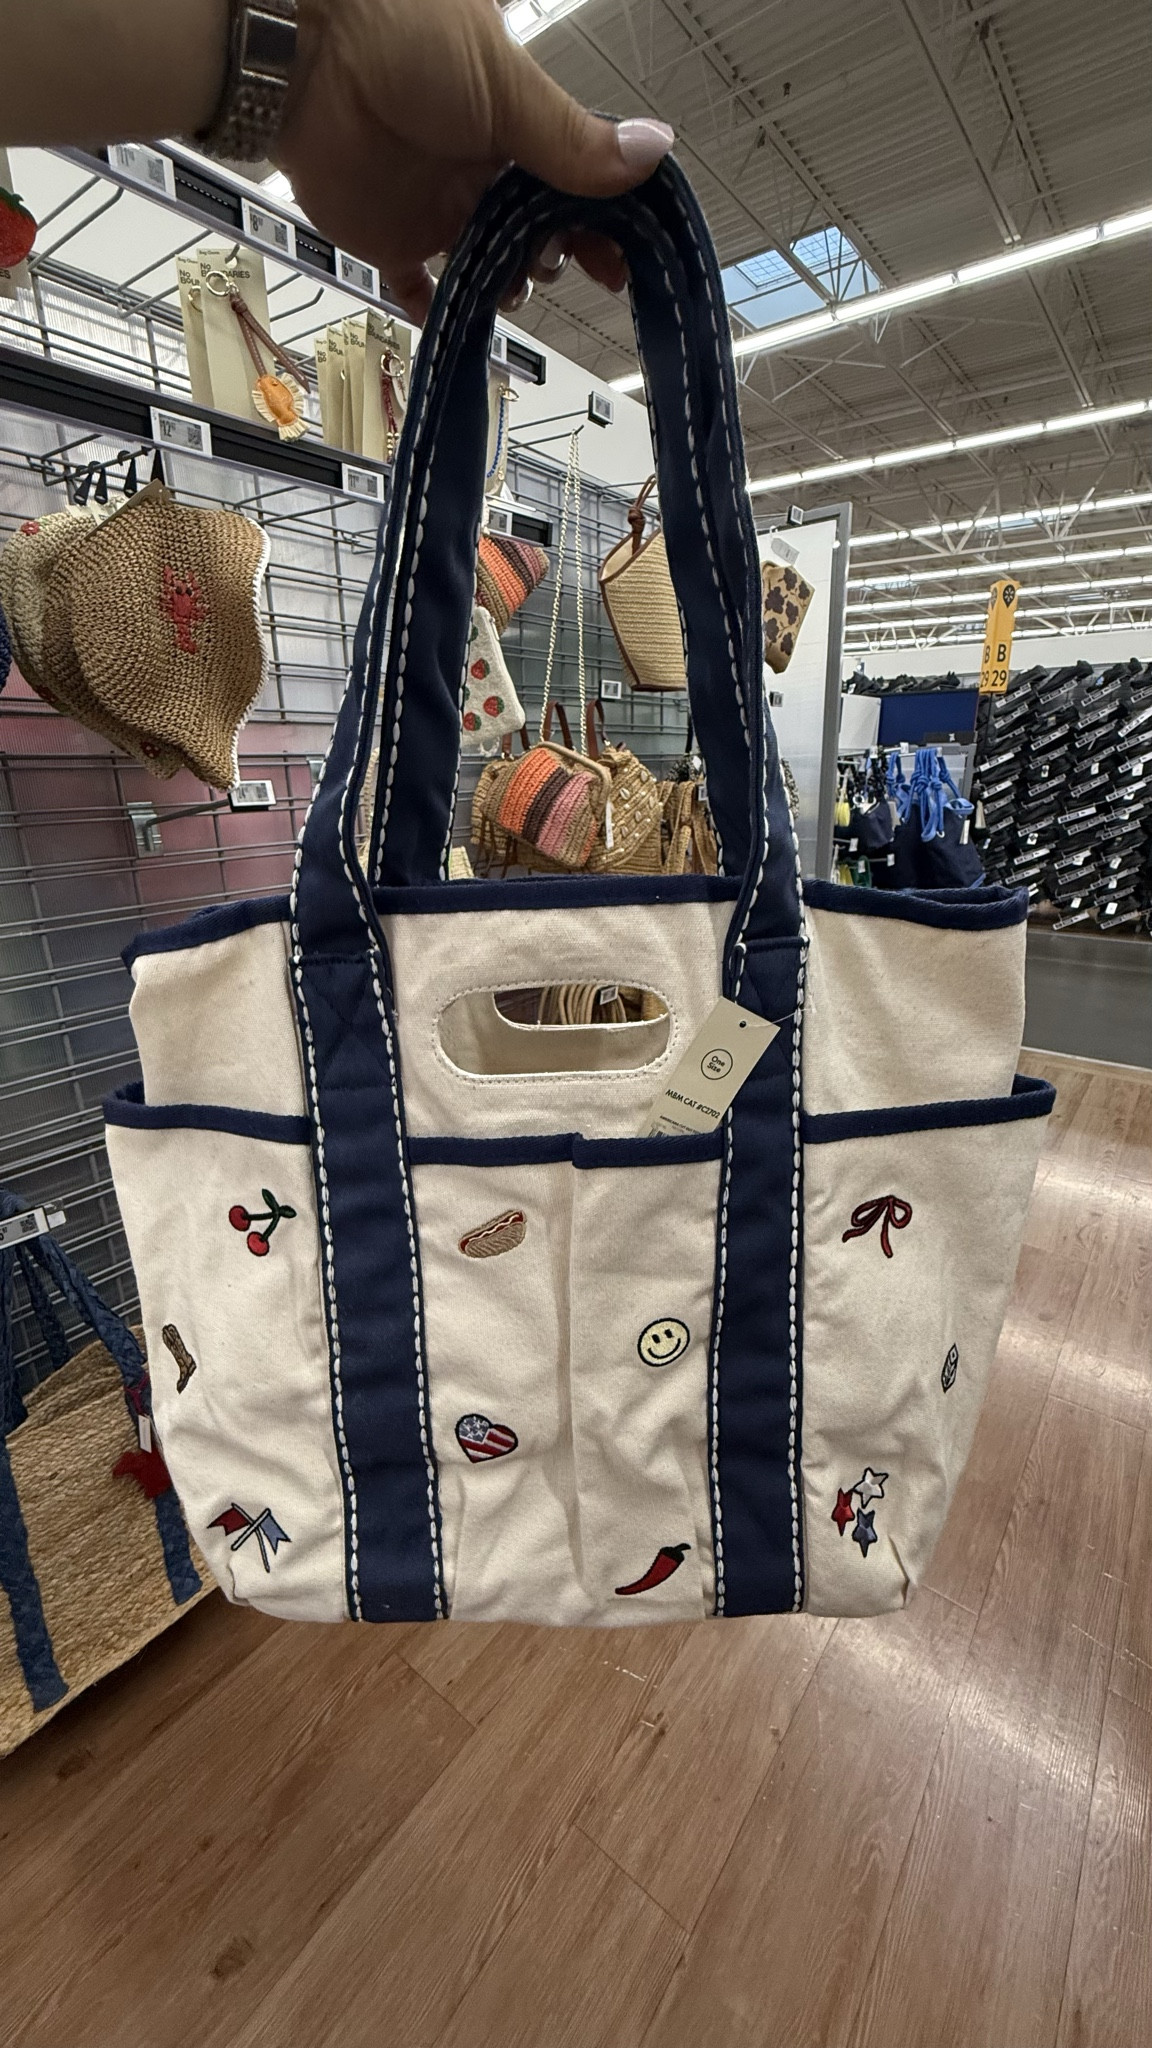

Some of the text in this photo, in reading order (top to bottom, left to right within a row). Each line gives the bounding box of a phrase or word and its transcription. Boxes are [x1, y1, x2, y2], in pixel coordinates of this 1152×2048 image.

[997, 643, 1007, 662] B
[991, 669, 1007, 687] 29
[707, 1061, 721, 1073] Size
[711, 1055, 725, 1067] One
[683, 1097, 698, 1108] CAT
